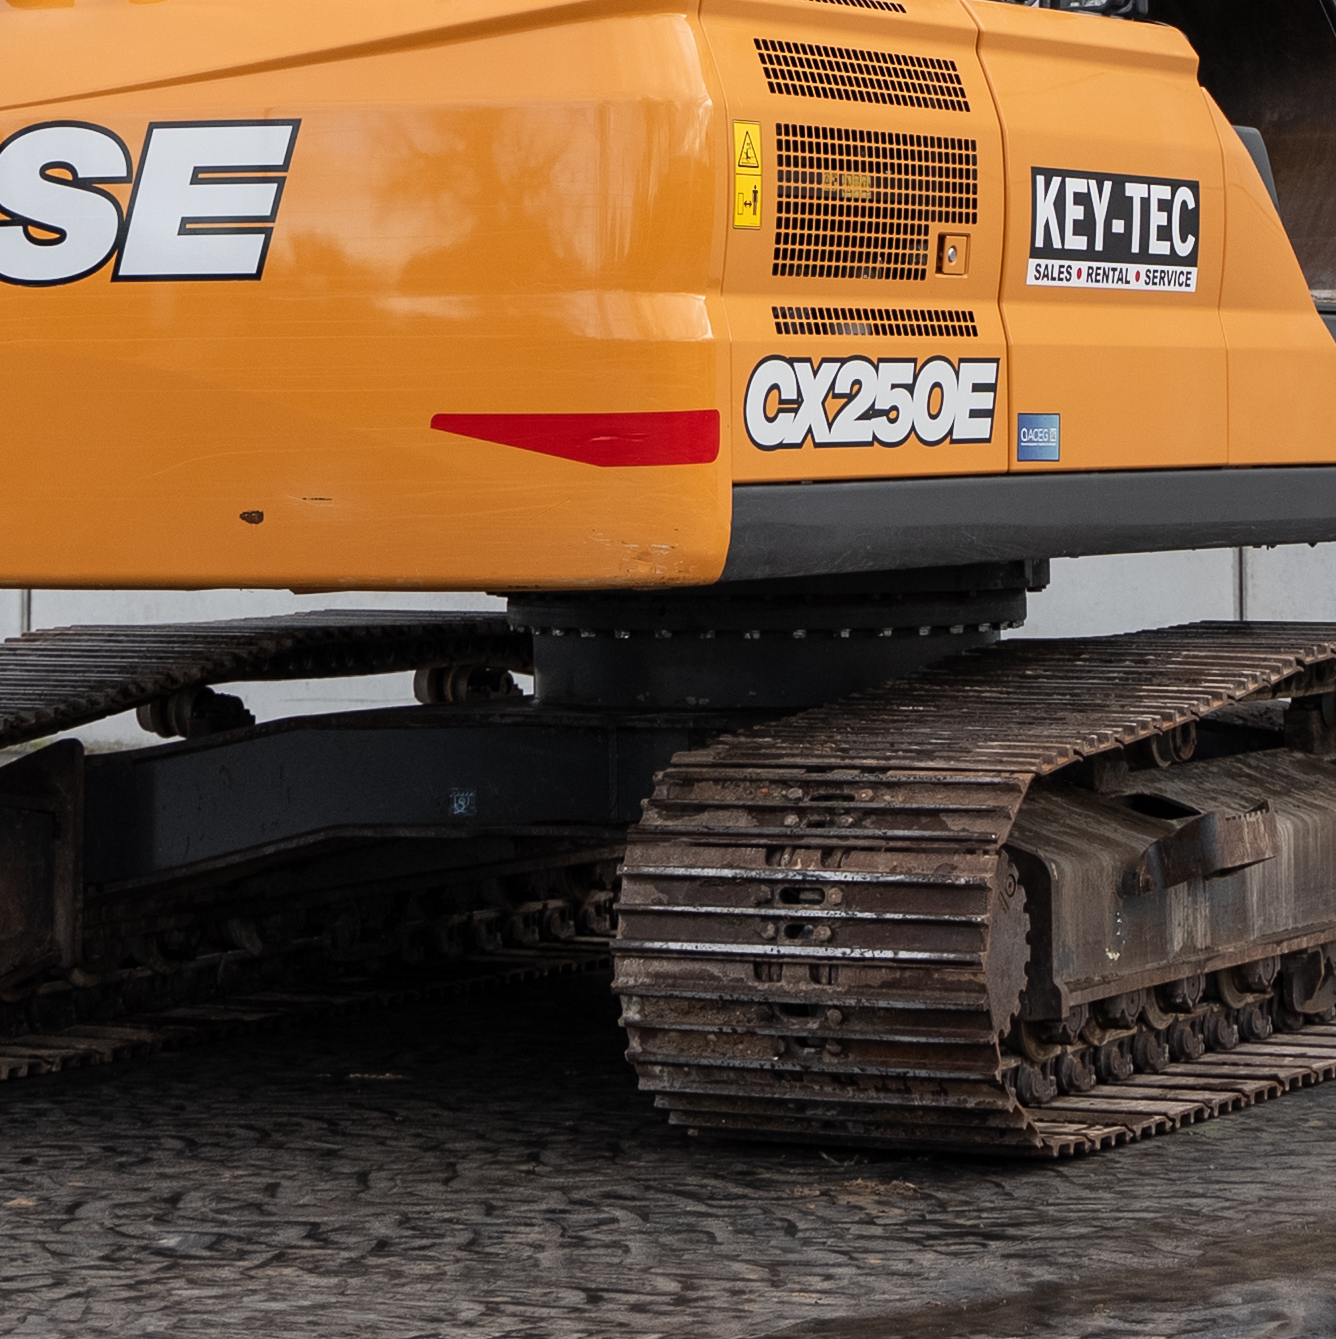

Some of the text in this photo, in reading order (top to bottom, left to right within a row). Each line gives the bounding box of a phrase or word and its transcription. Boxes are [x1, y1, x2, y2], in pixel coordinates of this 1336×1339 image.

[1034, 174, 1196, 257] KEY-TEC
[1034, 263, 1192, 288] SALES RENTAL SERVICE
[744, 355, 1001, 451] CX250E
